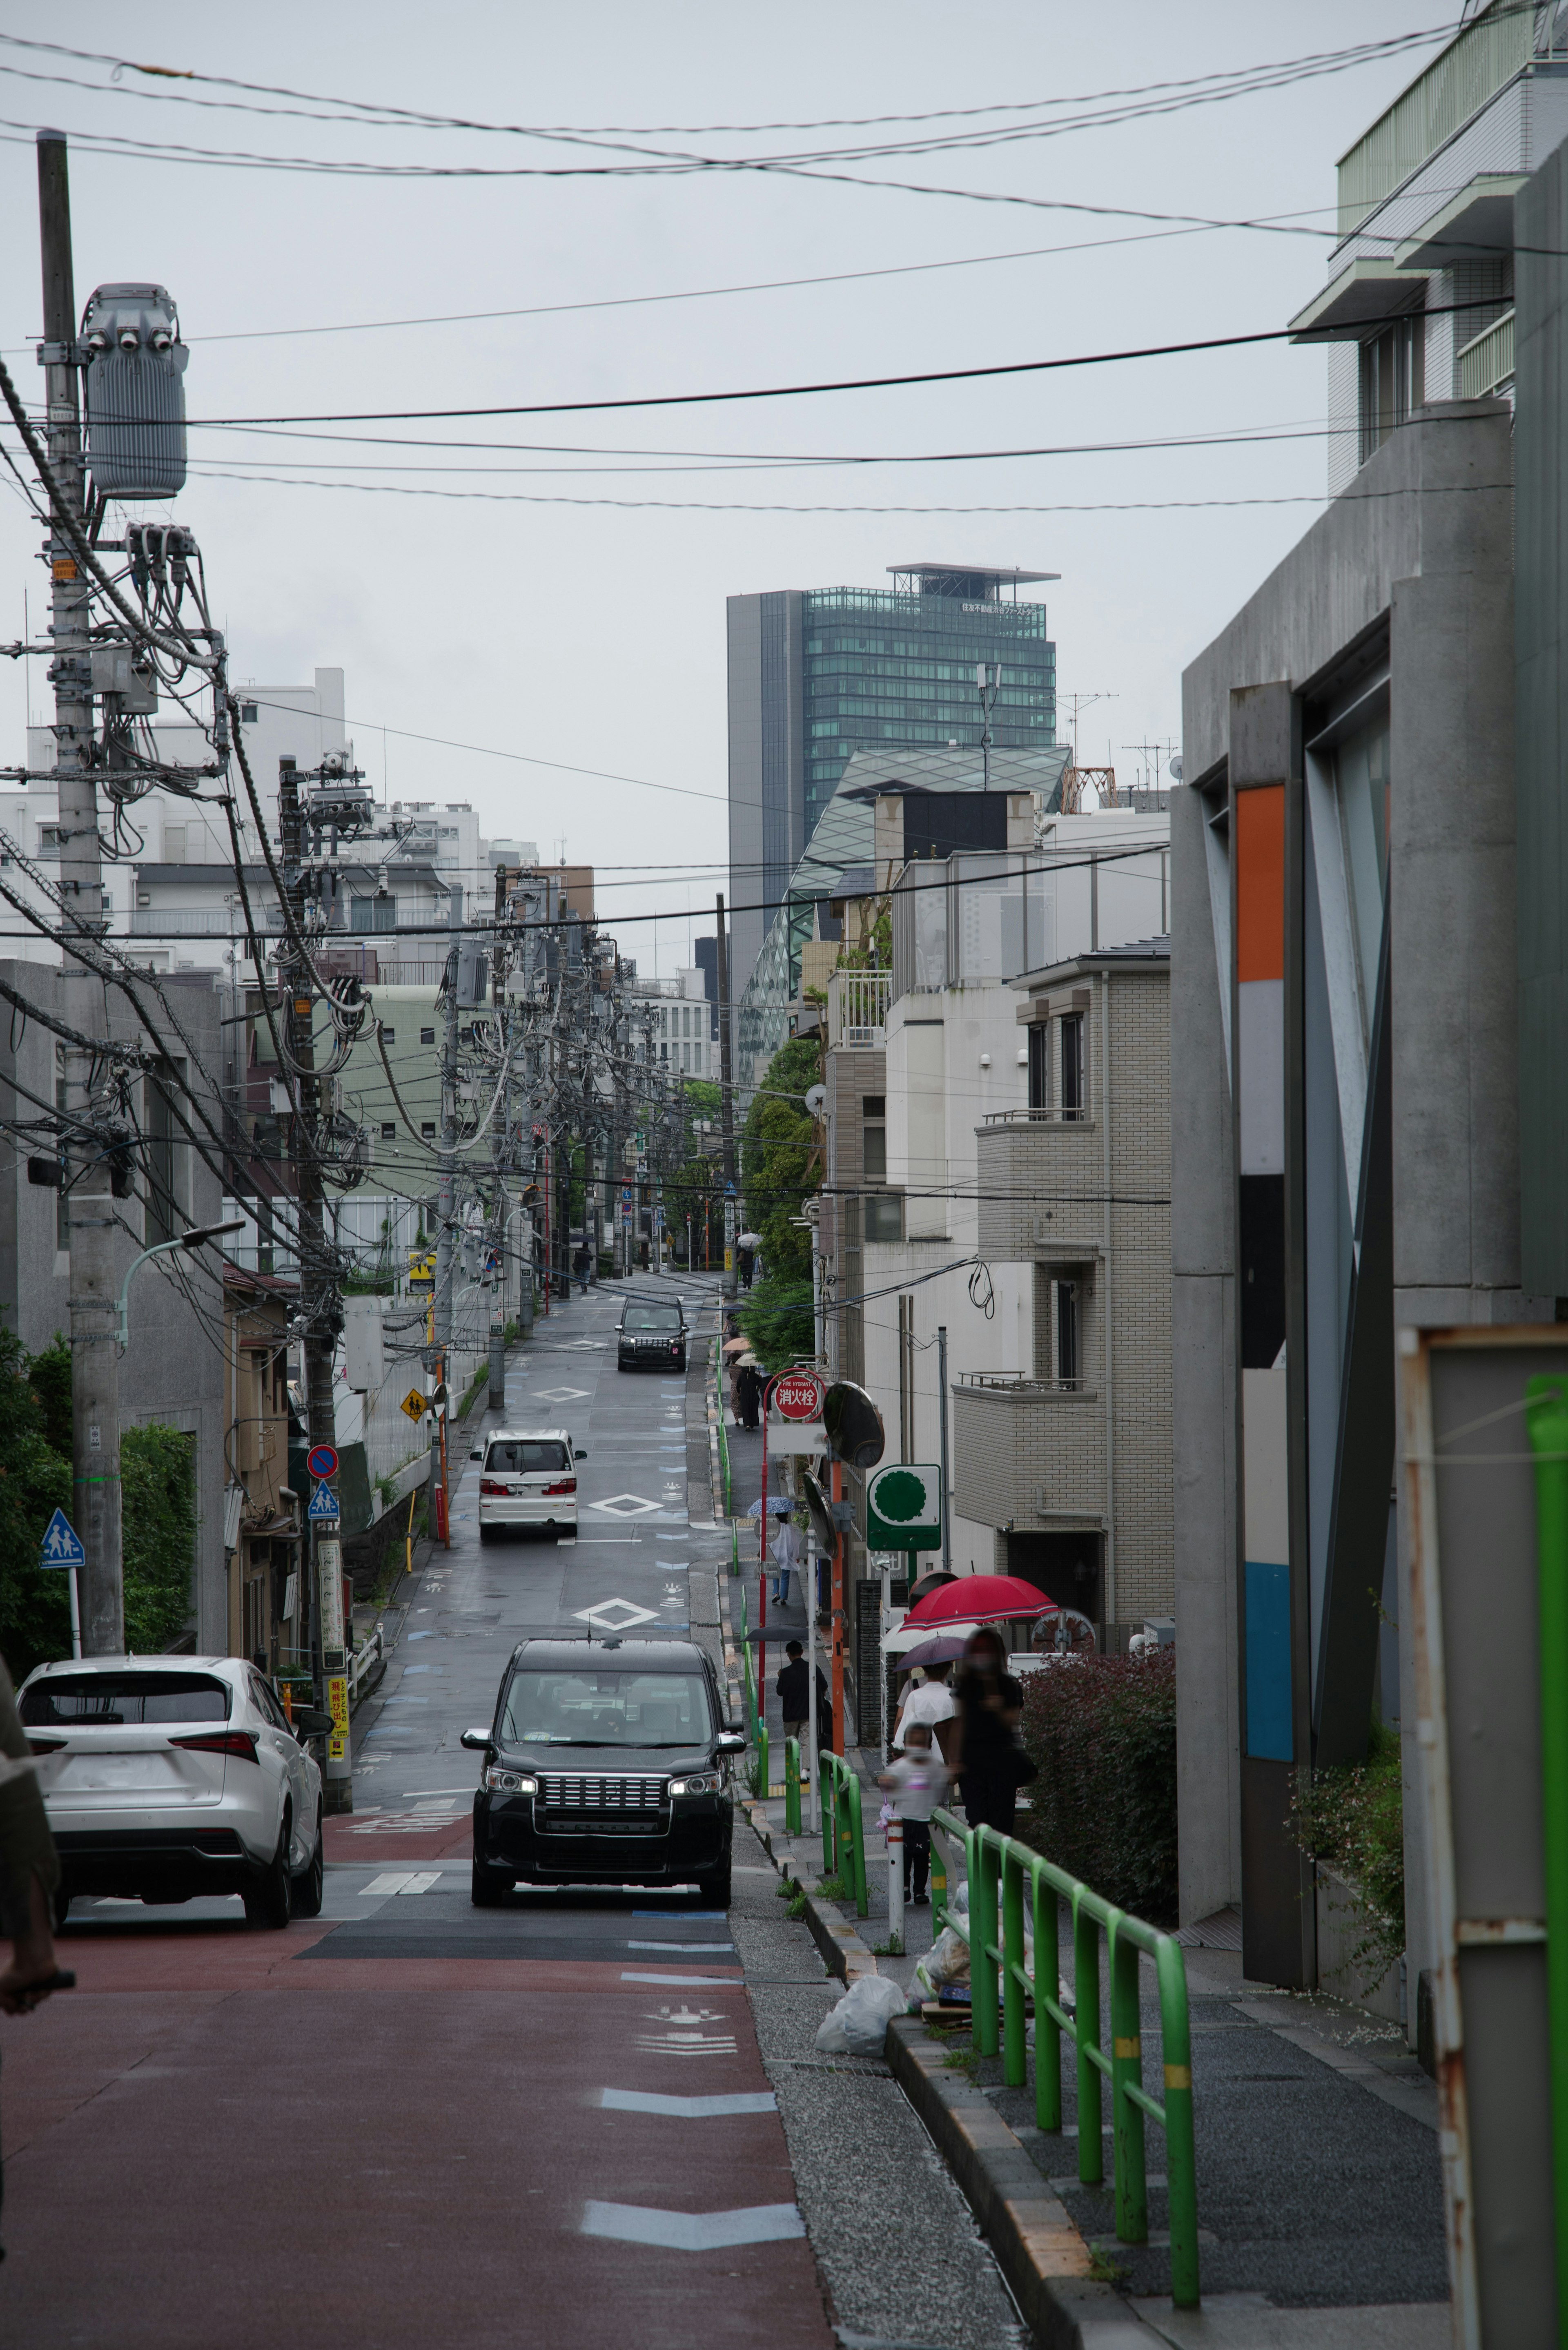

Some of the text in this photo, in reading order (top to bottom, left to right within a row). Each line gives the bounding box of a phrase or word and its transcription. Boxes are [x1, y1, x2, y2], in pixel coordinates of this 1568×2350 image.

[962, 602, 1040, 616] 住友不動産渋谷ファーストタワー
[779, 1389, 815, 1406] 消火栓
